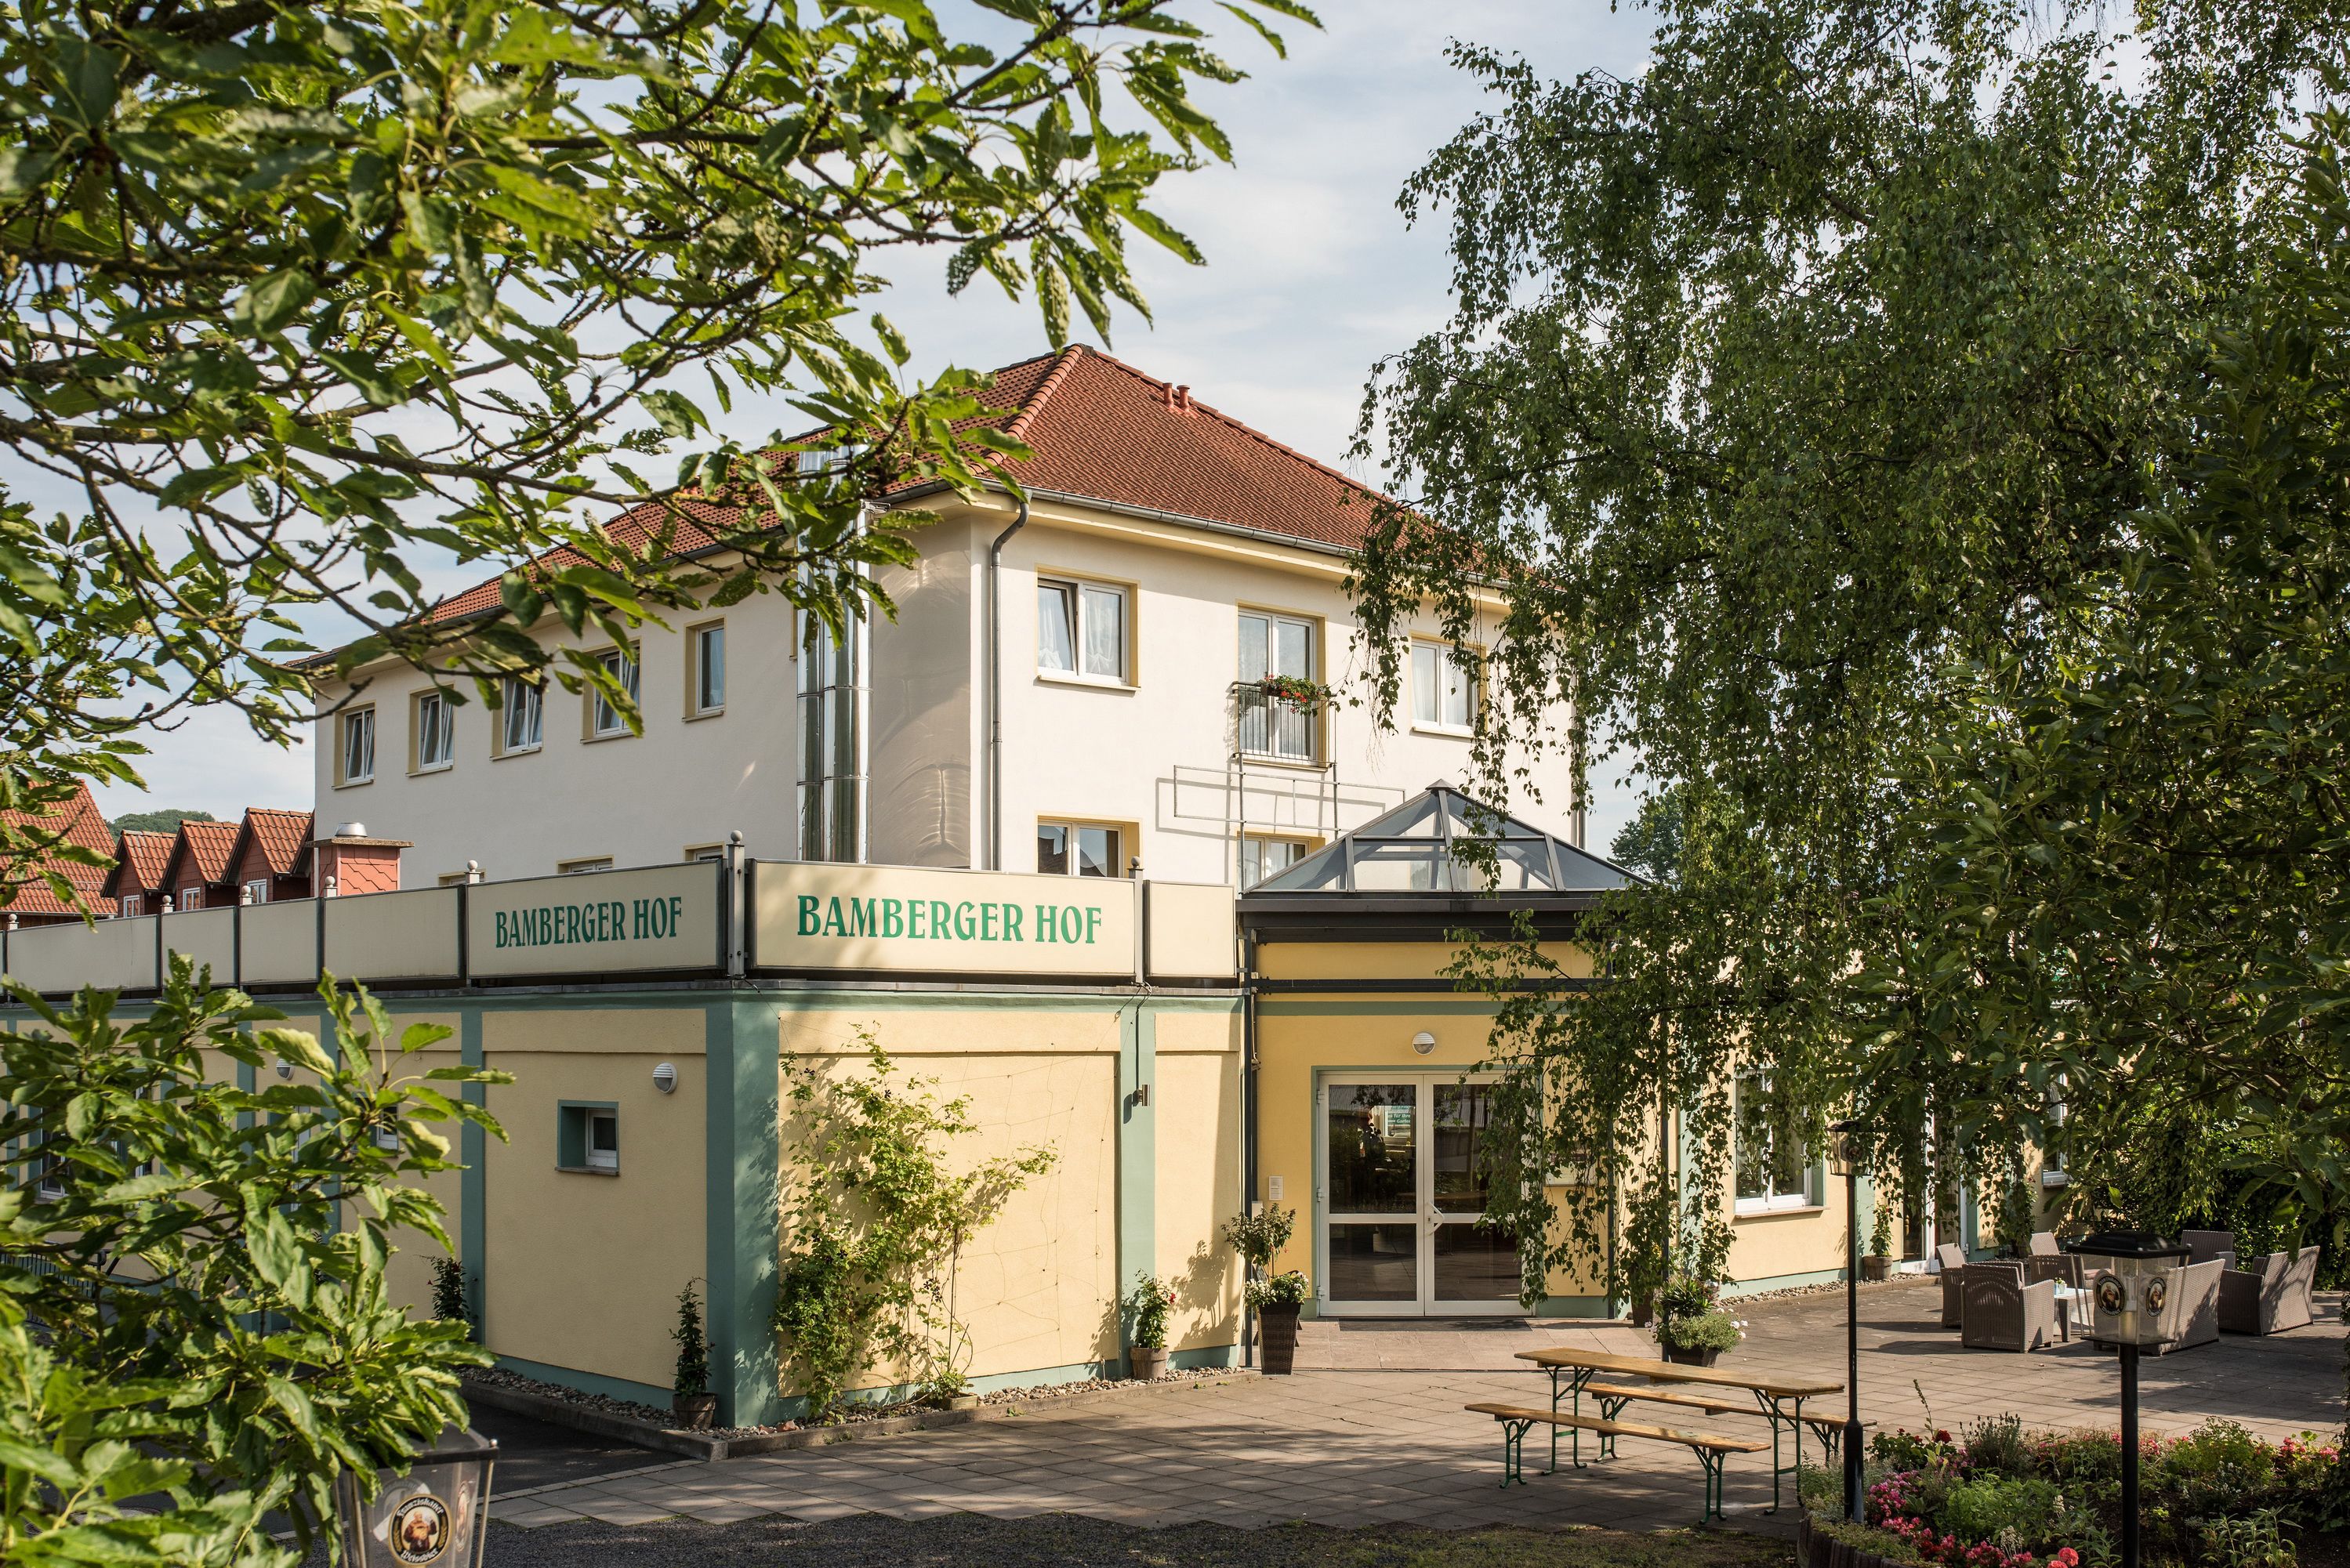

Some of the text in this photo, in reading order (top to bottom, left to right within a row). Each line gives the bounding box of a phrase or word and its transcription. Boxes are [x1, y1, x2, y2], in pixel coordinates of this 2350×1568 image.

[495, 896, 681, 948] BAMBERGER HOF
[798, 896, 1101, 943] BAMBERGER HOF
